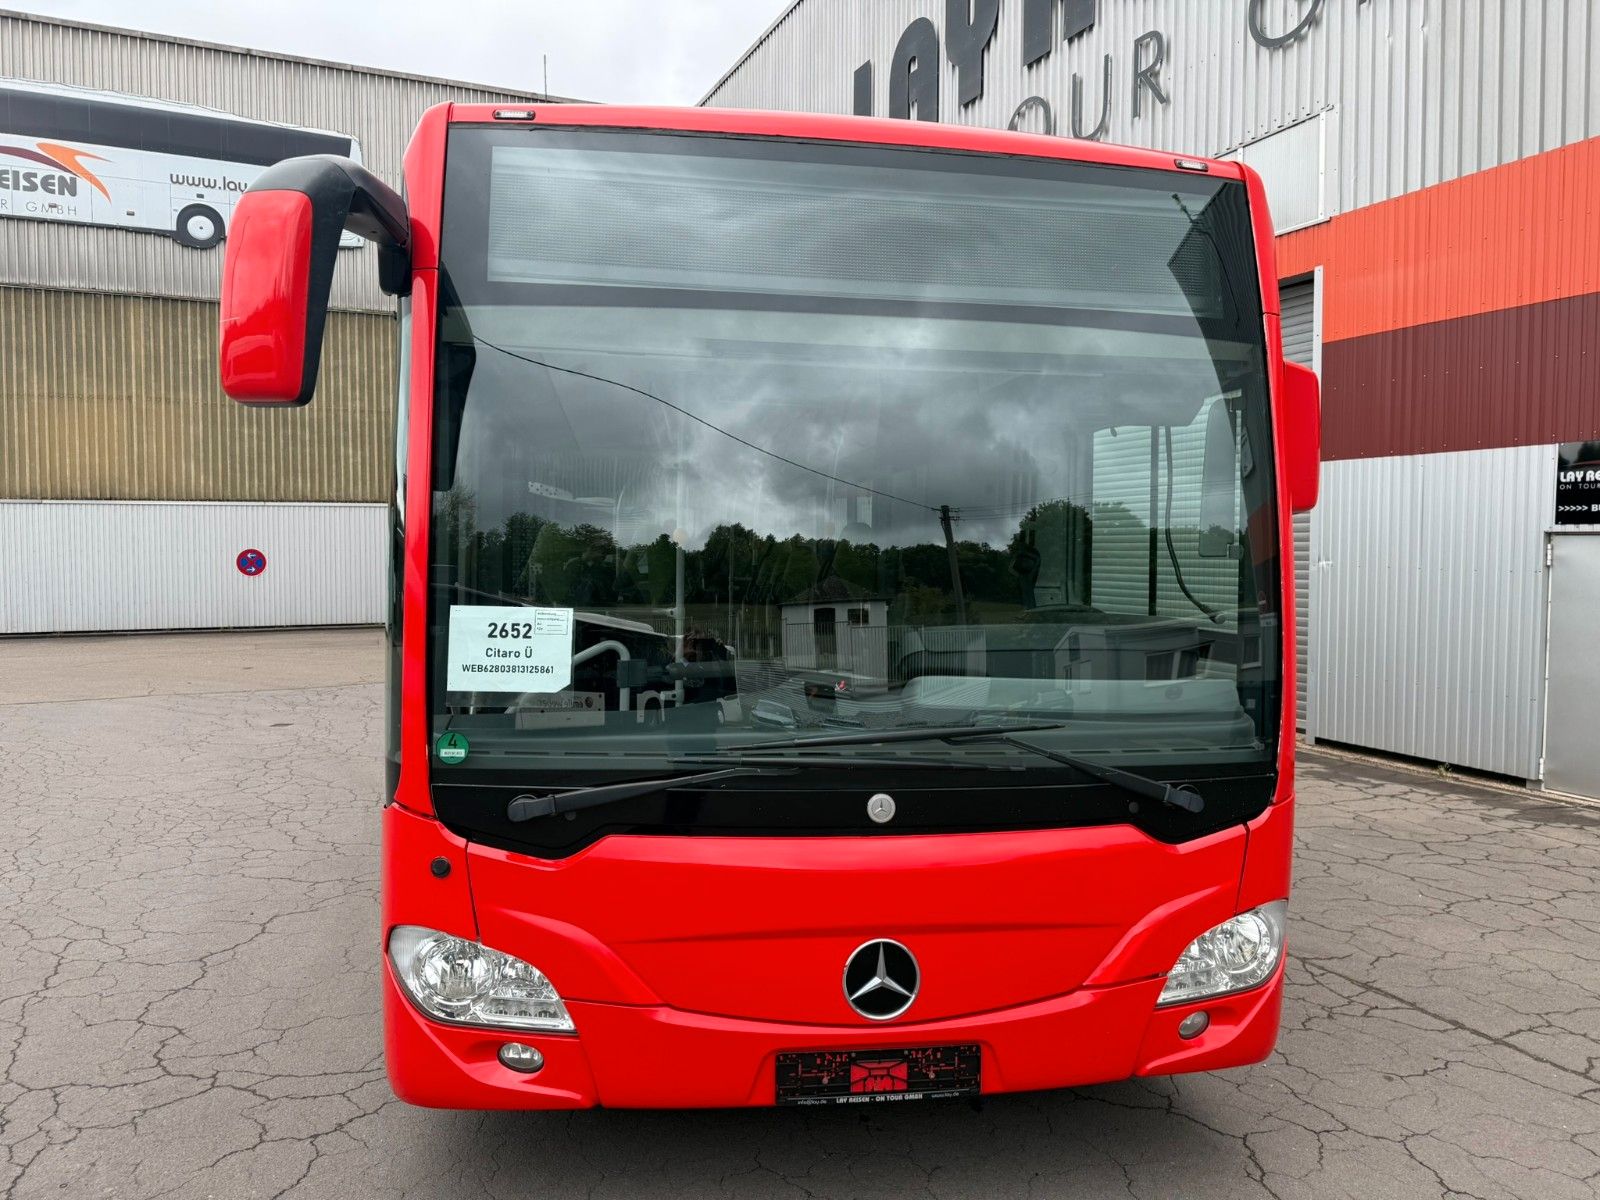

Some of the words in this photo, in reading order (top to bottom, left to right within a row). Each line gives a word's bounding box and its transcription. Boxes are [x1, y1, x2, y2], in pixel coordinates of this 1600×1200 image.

[26, 201, 77, 216] GMBH
[1560, 471, 1584, 482] LAY
[487, 622, 532, 639] 2652
[485, 647, 521, 658] Citaro
[524, 646, 533, 659] Ü
[462, 664, 554, 674] WEB62803813125861
[447, 733, 458, 749] 4
